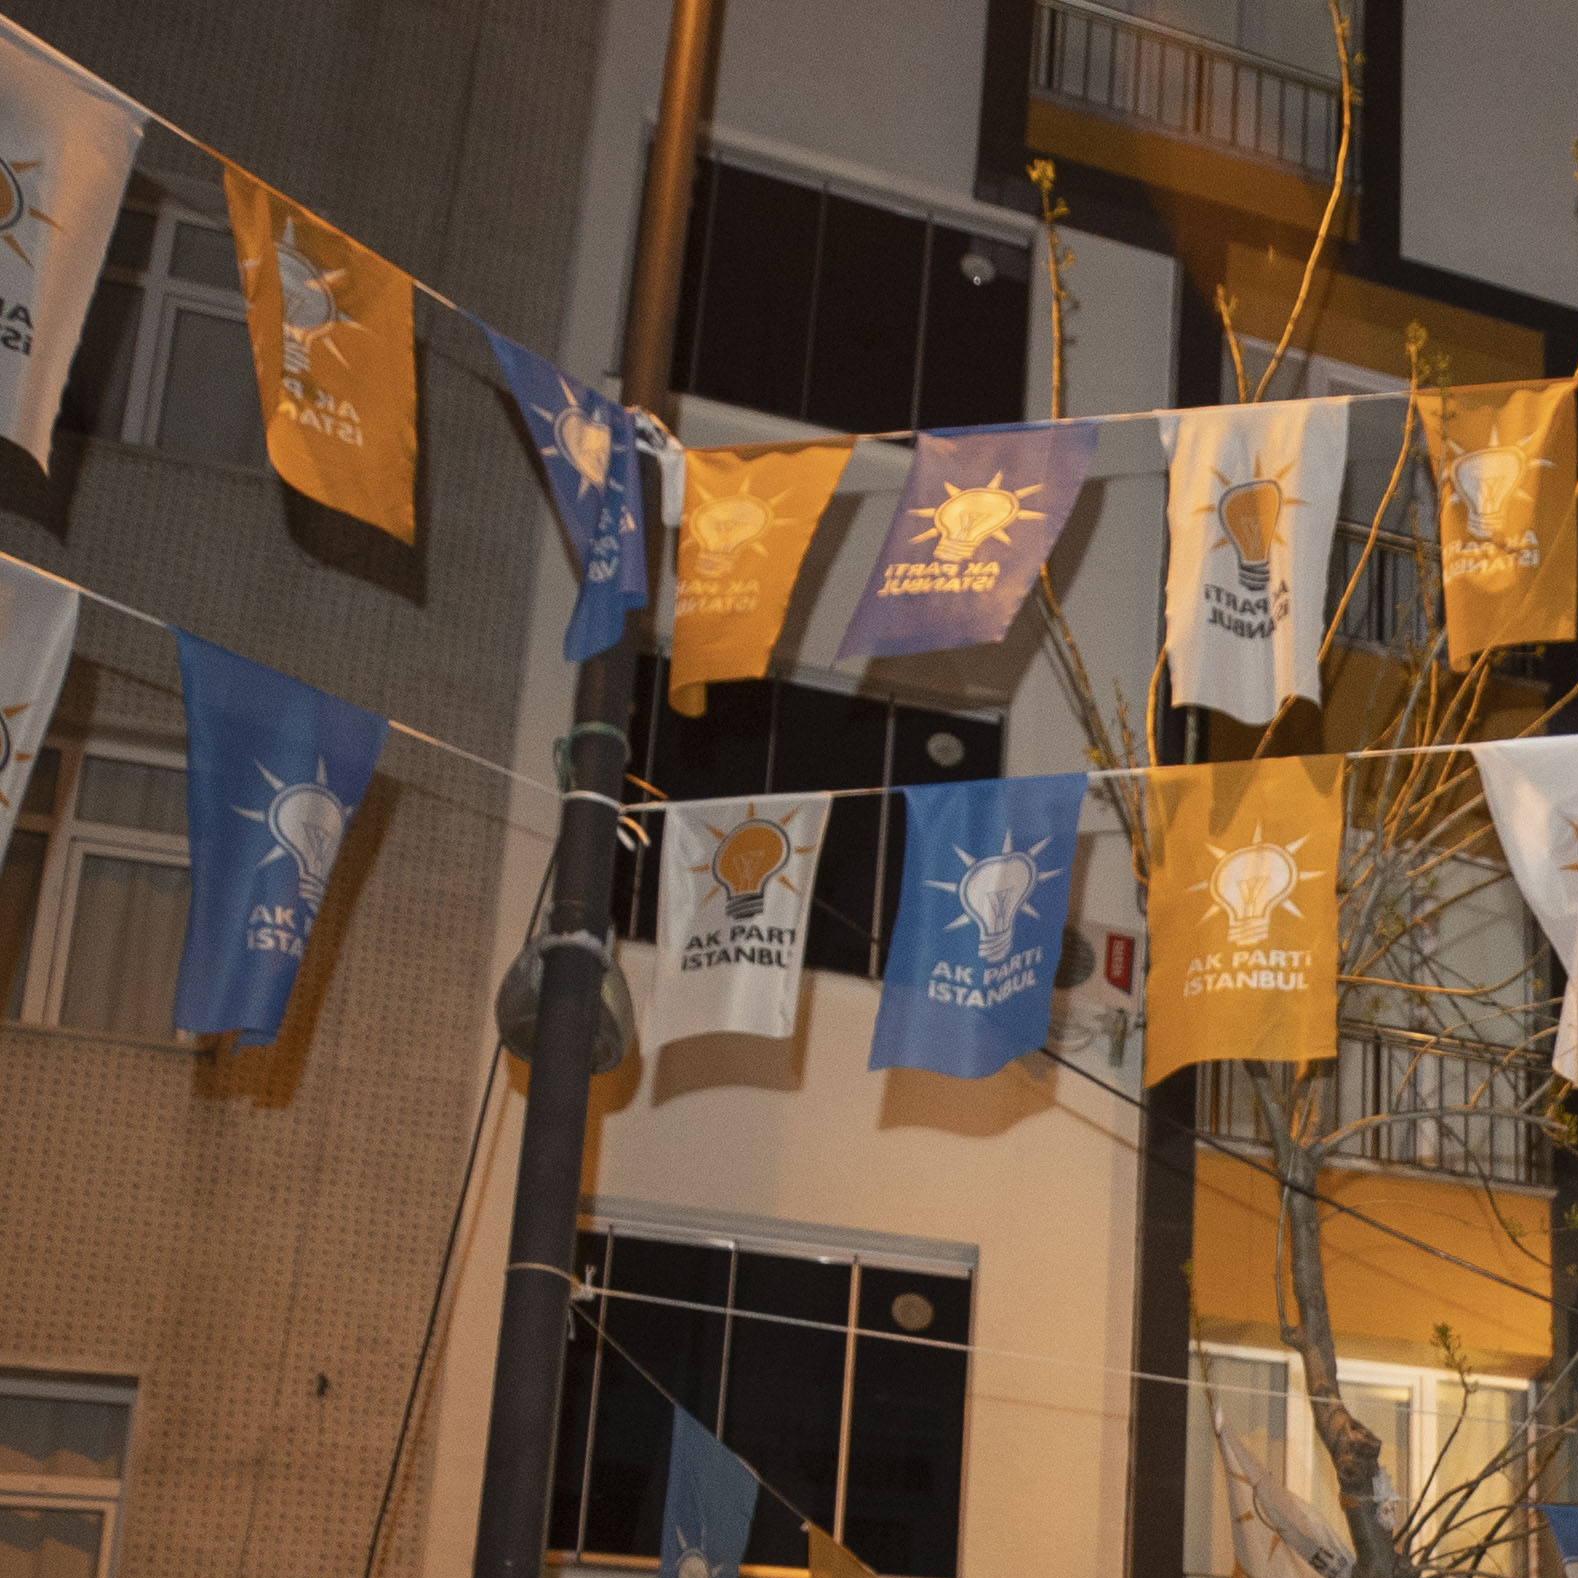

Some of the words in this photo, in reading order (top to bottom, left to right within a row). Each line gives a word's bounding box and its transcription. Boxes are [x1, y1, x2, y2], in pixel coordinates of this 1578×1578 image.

[685, 931, 722, 952] AK
[931, 961, 972, 984] AK
[1187, 953, 1225, 974] AK
